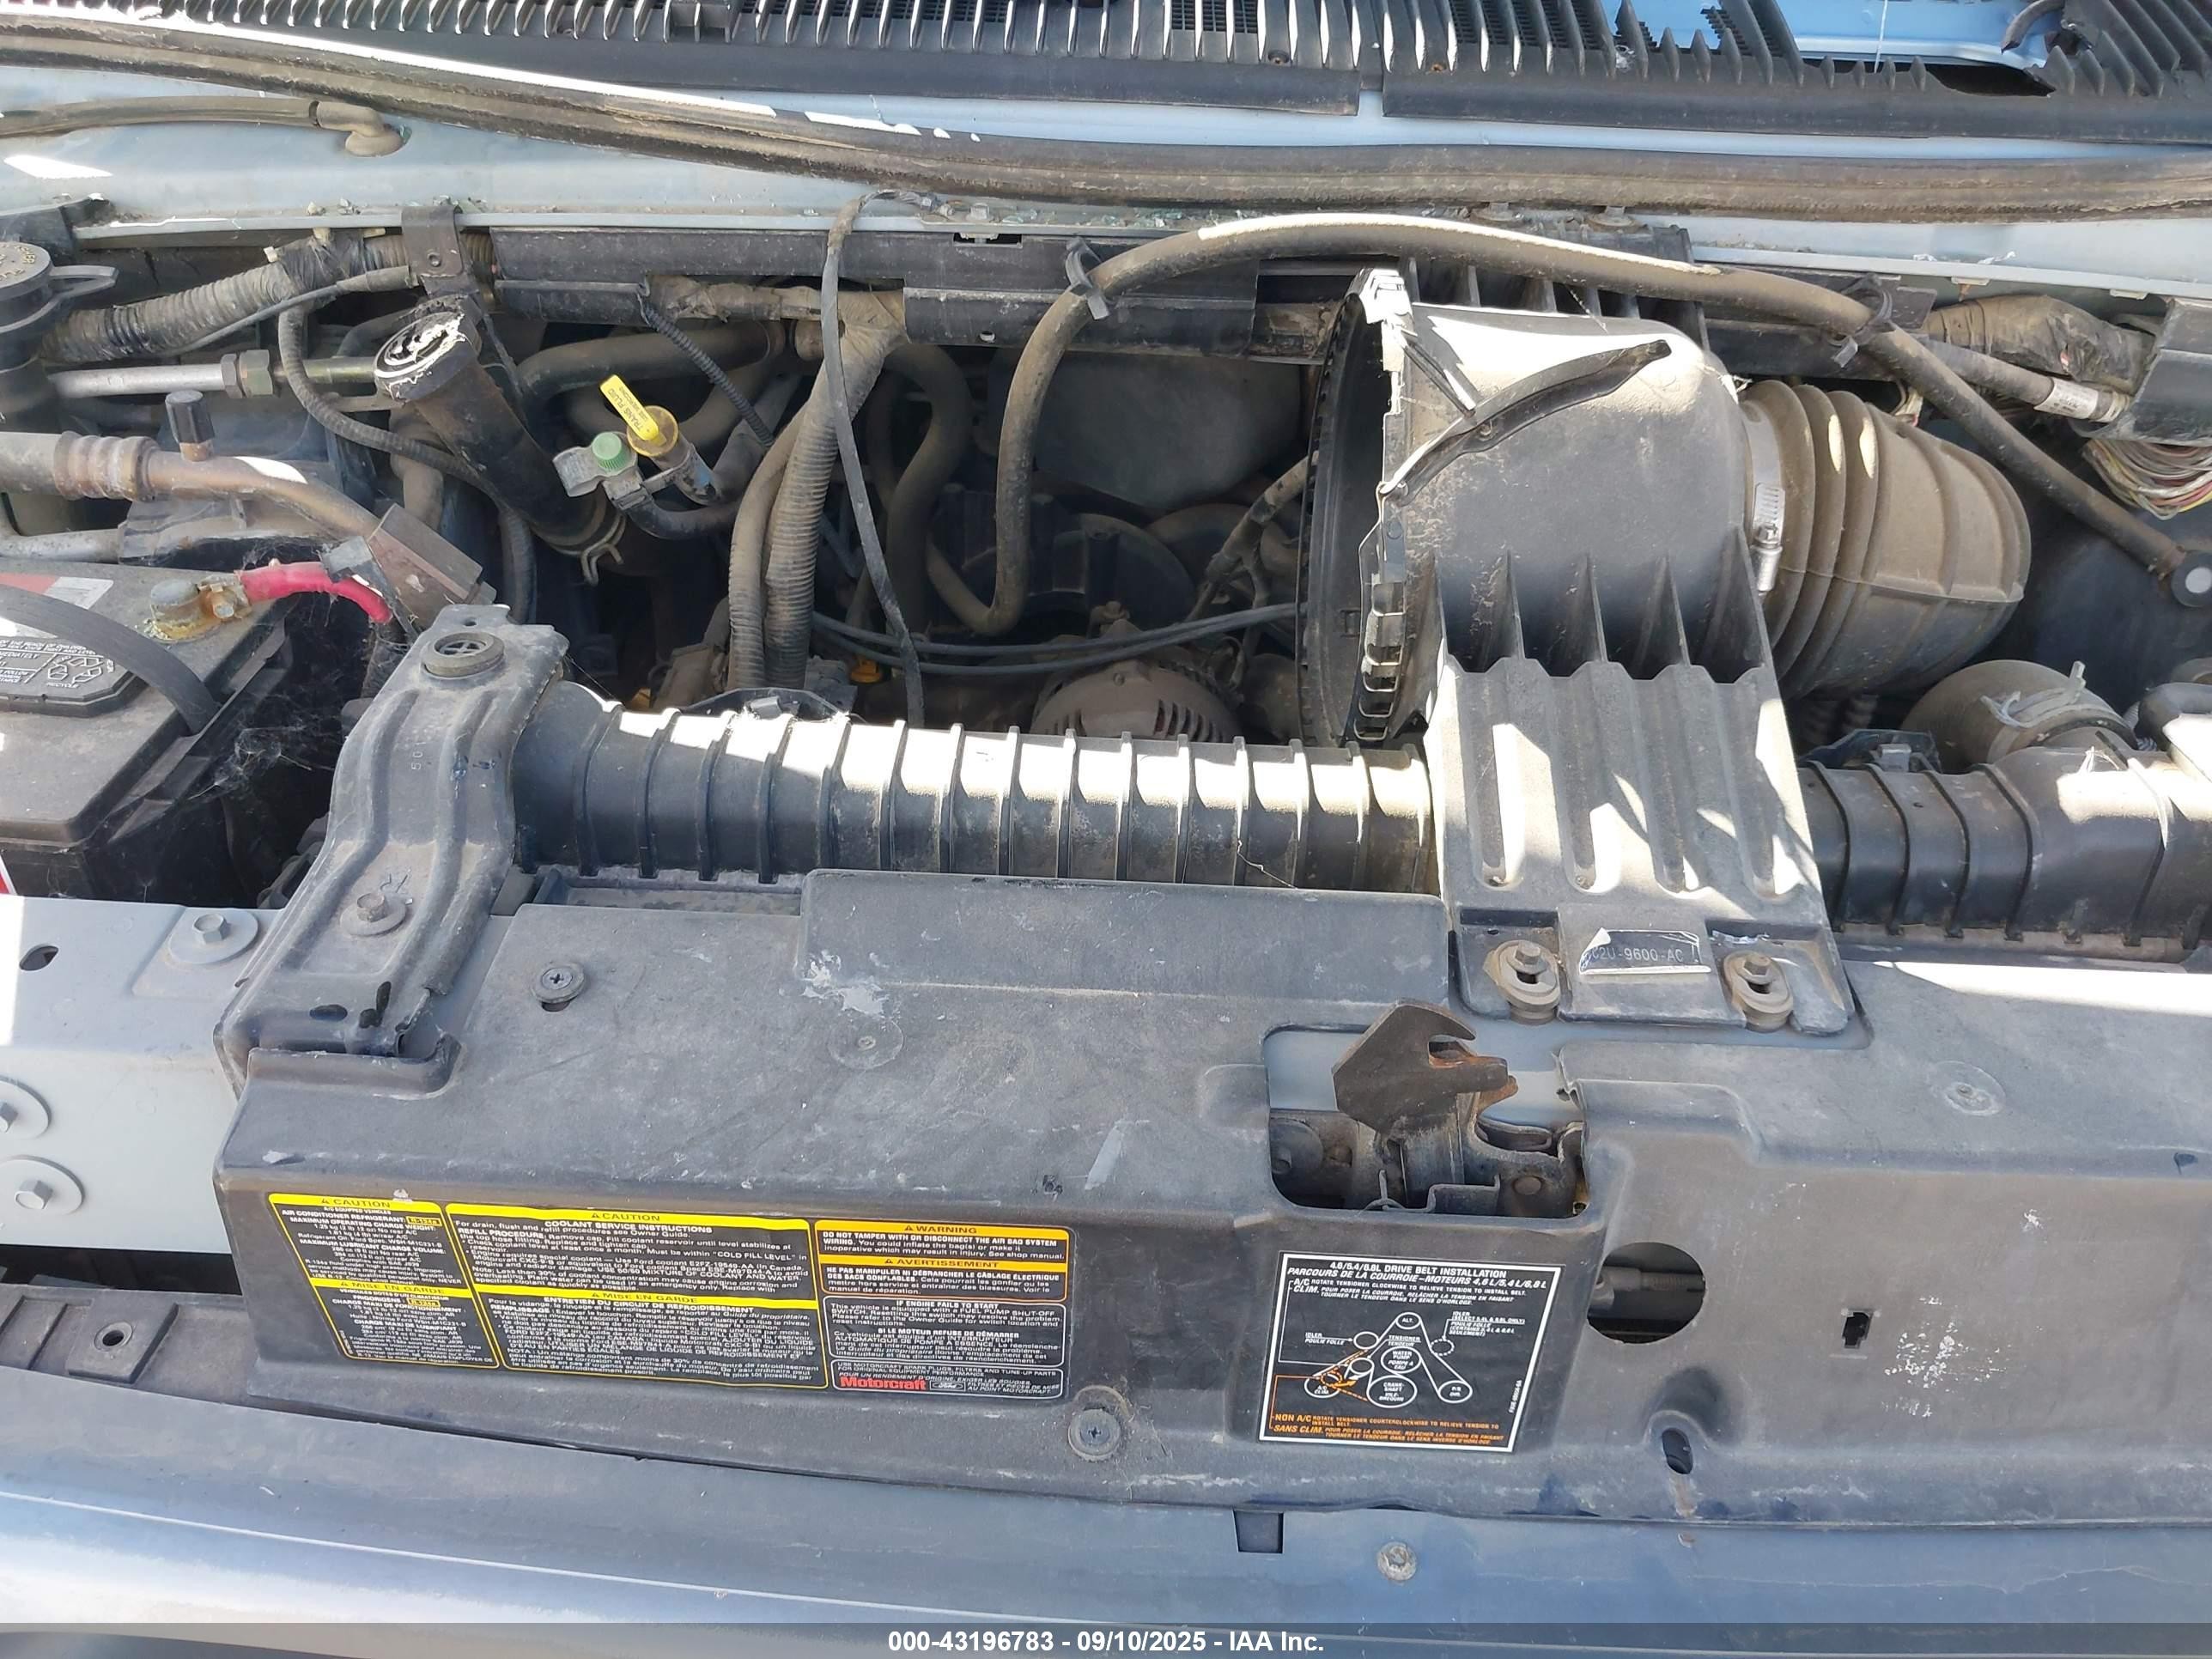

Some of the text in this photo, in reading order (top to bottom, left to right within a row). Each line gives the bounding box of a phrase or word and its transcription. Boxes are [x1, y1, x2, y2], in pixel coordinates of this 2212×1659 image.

[639, 1224, 712, 1233] INSTRUCTIONS
[896, 1258, 999, 1267] AVERTISSEMENT
[912, 1268, 963, 1277] DÉBRANCHER
[1013, 1272, 1059, 1280] ÉLECTRIQUE
[1287, 1267, 1338, 1277] PARCOURS
[1439, 1267, 1507, 1278] INSTALLATION
[1292, 1285, 1320, 1293] CLIM.
[840, 1376, 926, 1389] Motorcraft
